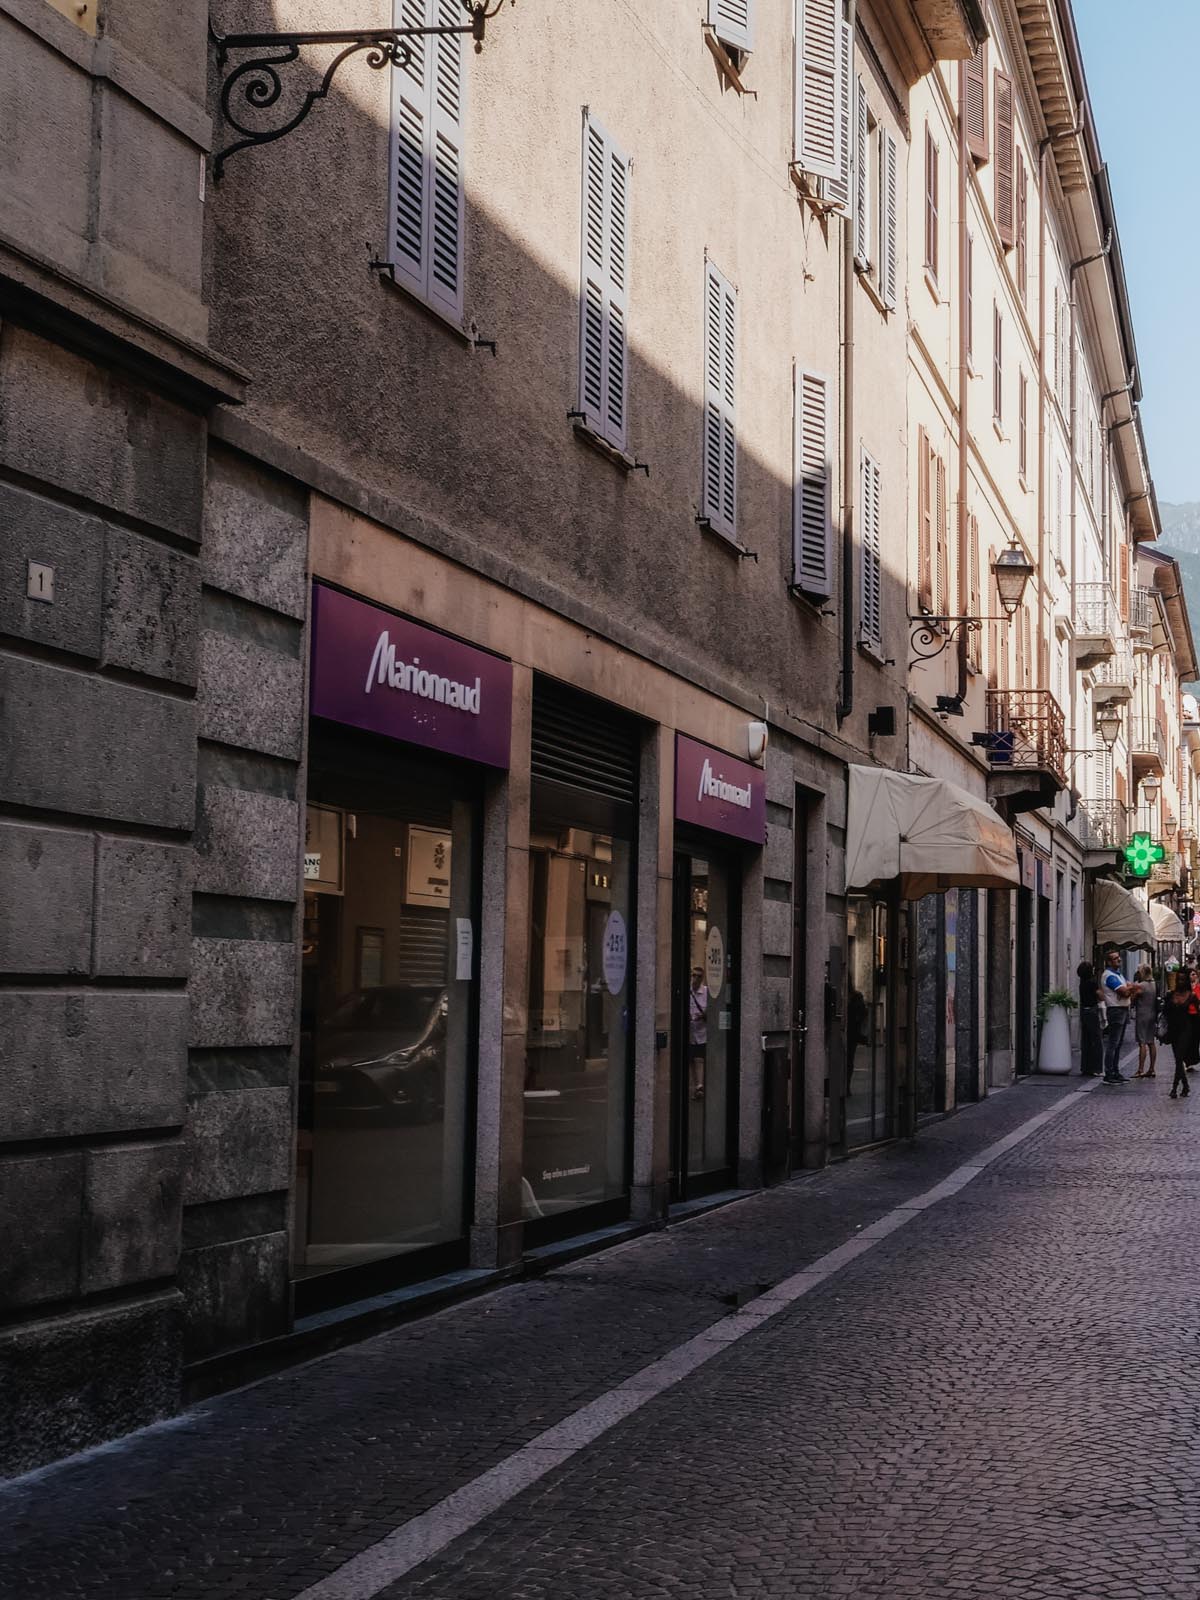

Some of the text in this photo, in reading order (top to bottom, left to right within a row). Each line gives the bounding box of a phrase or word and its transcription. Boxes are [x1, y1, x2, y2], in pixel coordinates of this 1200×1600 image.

[38, 571, 44, 592] 1
[364, 630, 481, 715] Marionnaud
[697, 758, 752, 809] Marionnaud
